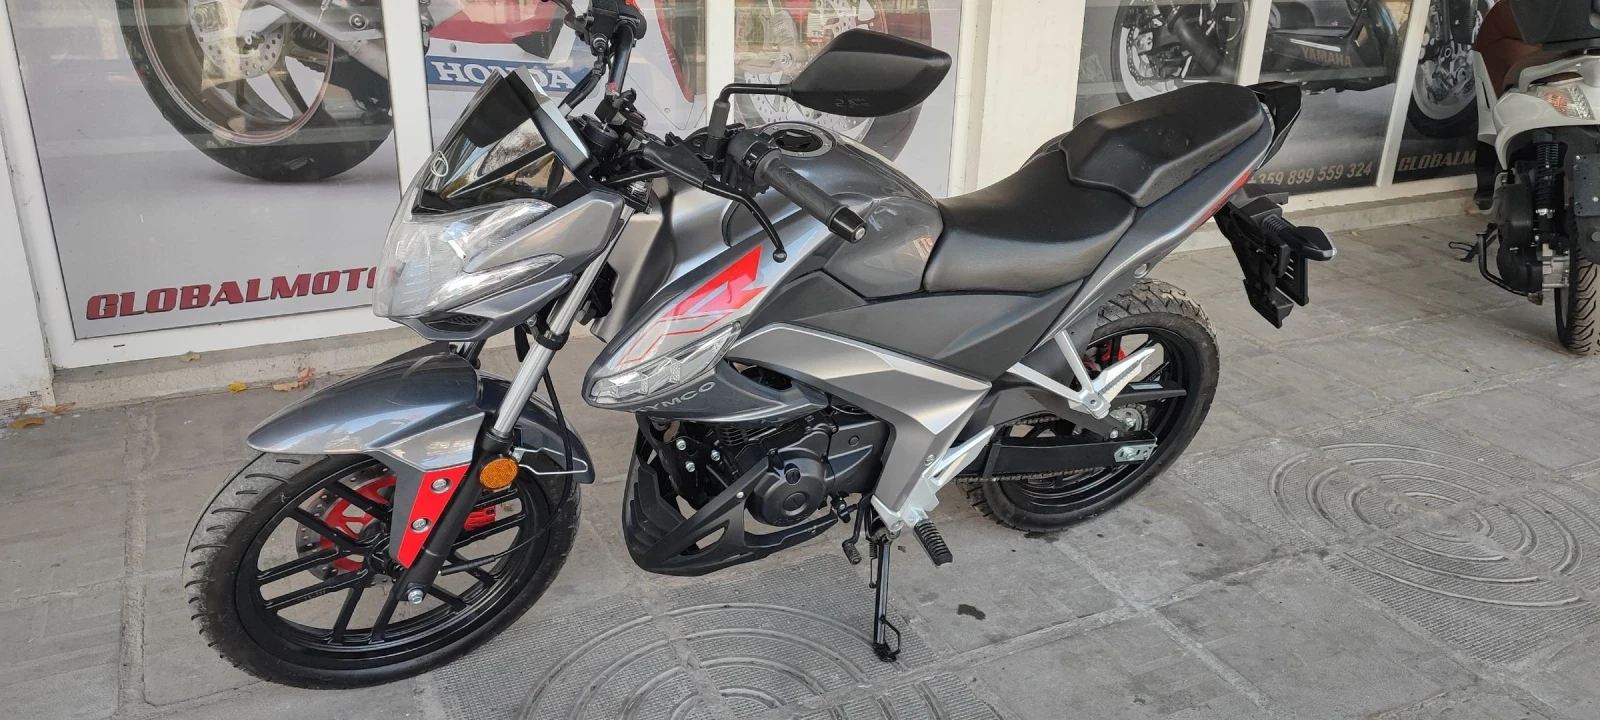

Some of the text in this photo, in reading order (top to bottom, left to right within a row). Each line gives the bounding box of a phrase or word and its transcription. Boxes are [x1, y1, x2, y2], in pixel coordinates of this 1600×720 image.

[1302, 46, 1352, 68] YAMAHA
[1287, 167, 1314, 185] 899
[1317, 164, 1344, 182] 559
[1347, 161, 1373, 178] 324
